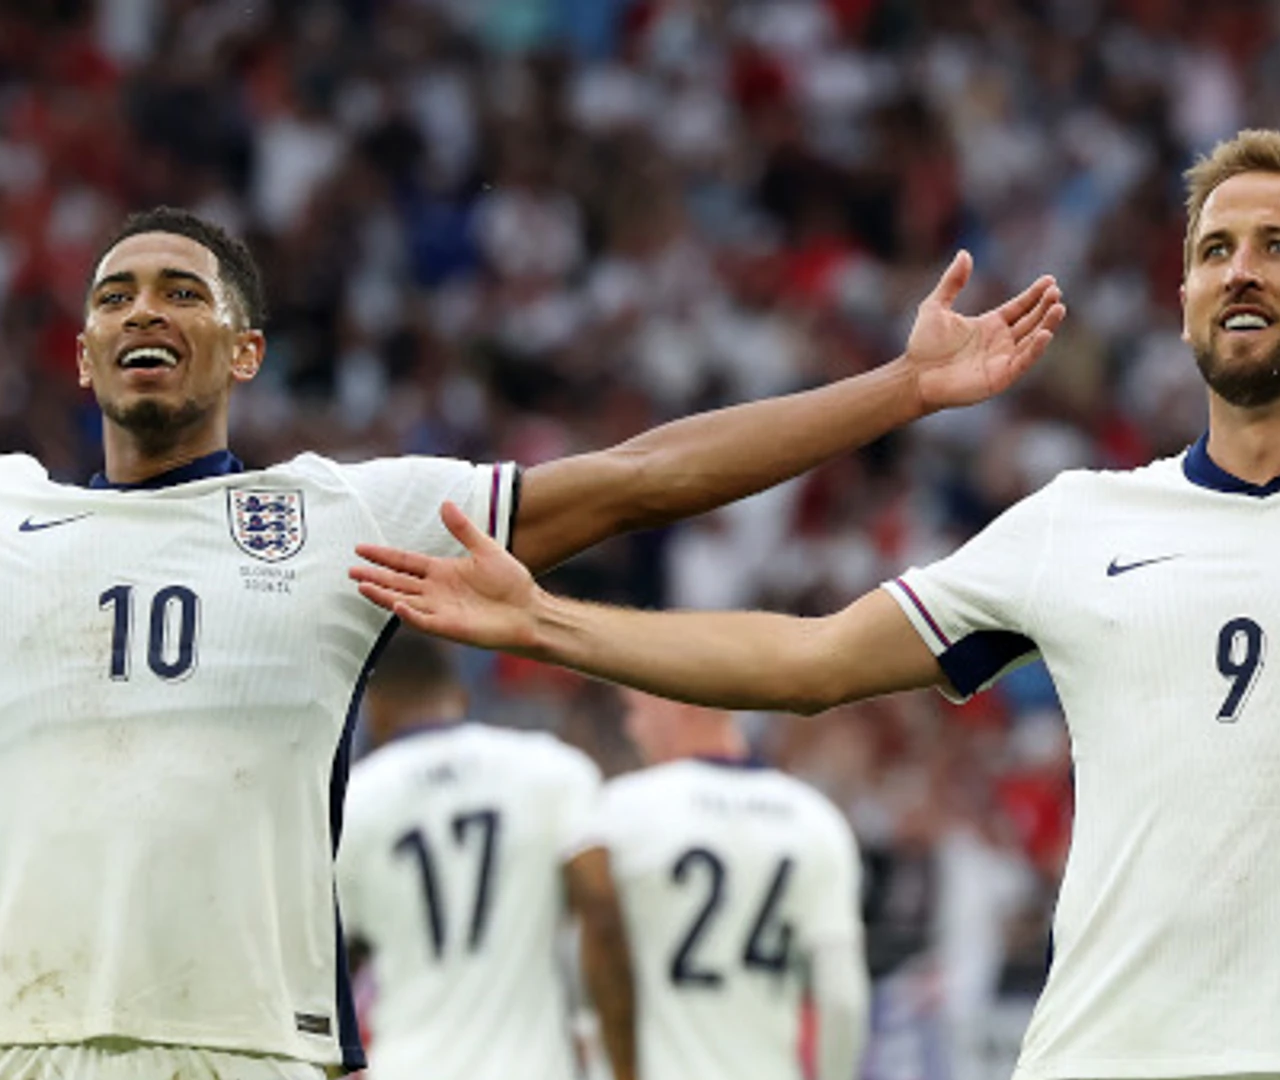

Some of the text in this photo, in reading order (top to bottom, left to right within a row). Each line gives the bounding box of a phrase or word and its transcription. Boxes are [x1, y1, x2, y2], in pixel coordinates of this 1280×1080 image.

[99, 585, 202, 684] 10
[1216, 617, 1268, 723] 9
[392, 808, 501, 962] 17
[670, 848, 797, 986] 24
